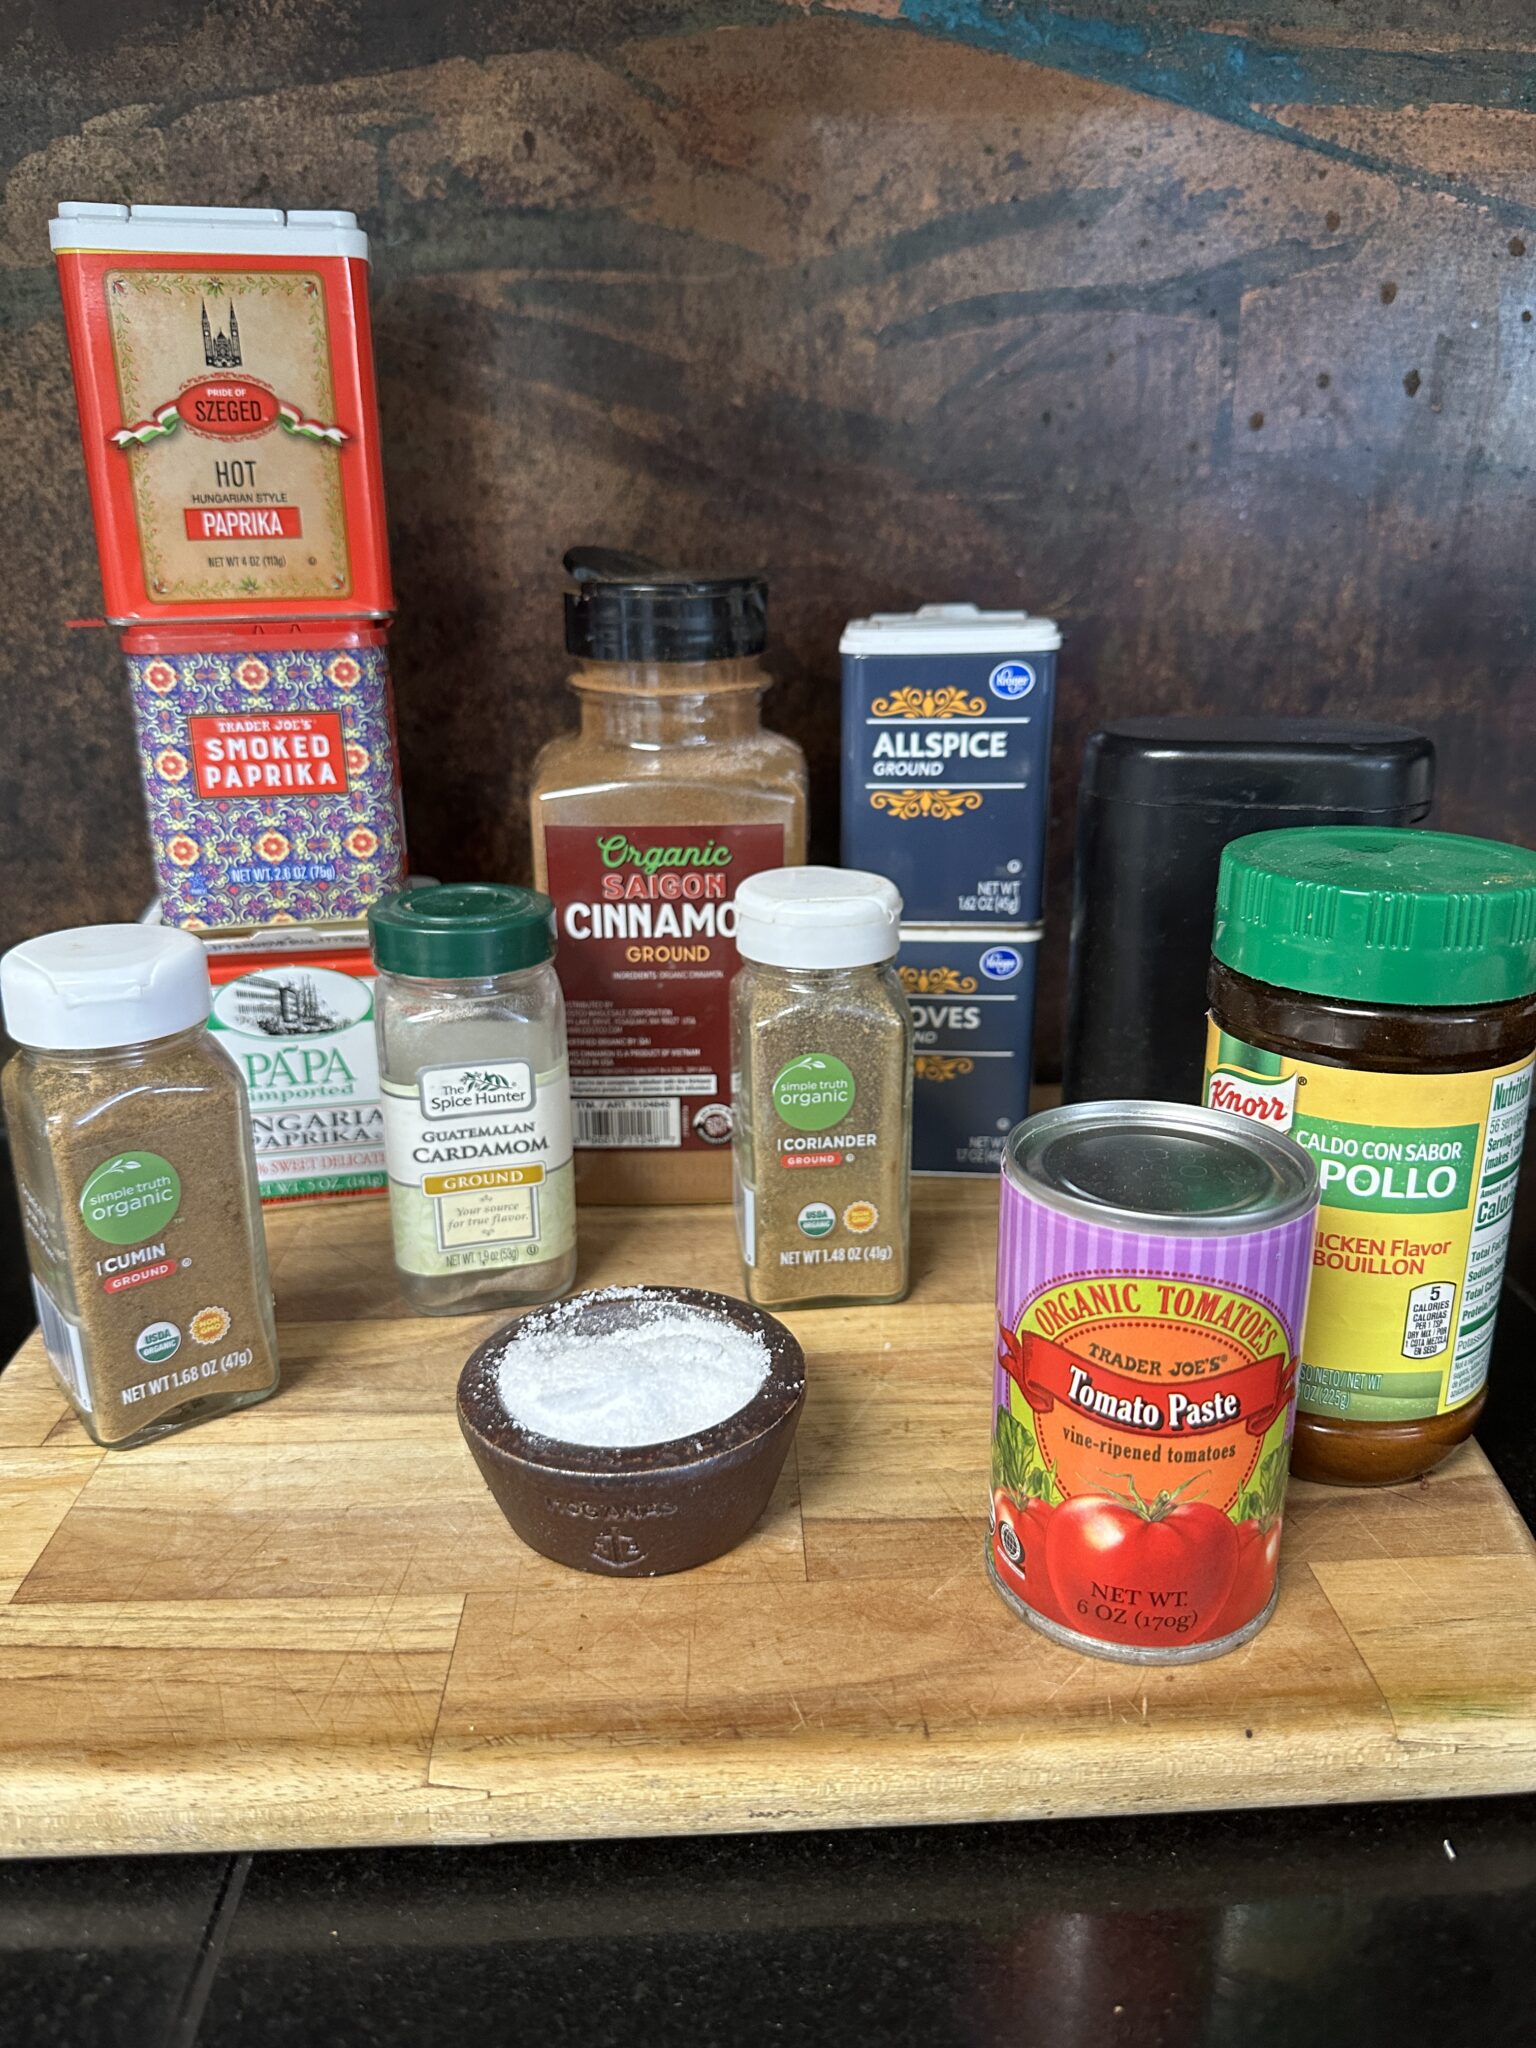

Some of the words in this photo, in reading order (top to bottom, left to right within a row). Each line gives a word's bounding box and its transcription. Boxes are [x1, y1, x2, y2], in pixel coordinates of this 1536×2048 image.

[206, 388, 232, 397] PRIDE
[234, 388, 246, 396] OF
[195, 400, 262, 422] SZEGED
[216, 461, 256, 488] HOT
[192, 494, 253, 504] HUNGARIAN
[256, 493, 288, 503] STYLE
[202, 510, 284, 537] PAPRIKA
[208, 557, 224, 568] NET
[224, 556, 239, 568] WT
[241, 556, 247, 566] 4
[249, 556, 260, 567] OZ
[996, 668, 1029, 694] Kroger
[218, 720, 272, 733] TRADER
[273, 719, 312, 732] JOE'S
[205, 734, 330, 761] SMOKED
[872, 731, 1008, 758] ALLSPICE
[205, 762, 337, 789] PAPRIKA
[873, 761, 944, 776] GROUND
[596, 834, 733, 875] Organic
[230, 868, 251, 882] NET
[252, 868, 273, 881] WT.
[294, 866, 307, 880] OZ
[310, 864, 335, 881] (75g)
[602, 873, 726, 900] SAIGON
[977, 880, 999, 896] NET
[1000, 880, 1022, 895] WT
[978, 896, 994, 912] OZ
[564, 902, 737, 940] CINNAMO
[626, 944, 710, 962] GROUND
[911, 1006, 981, 1030] OVES
[249, 1083, 354, 1104] imported
[443, 1086, 464, 1096] The
[781, 1081, 817, 1092] simple
[819, 1079, 848, 1089] truth
[432, 1096, 472, 1112] Spice
[475, 1092, 526, 1105] Hunter
[780, 1090, 848, 1106] organic
[1210, 1079, 1288, 1120] Knorr
[252, 1108, 384, 1133] NGARIA
[1490, 1118, 1500, 1134] 56
[422, 1122, 535, 1143] GUATEMALAN
[783, 1134, 877, 1151] CORIANDER
[1488, 1132, 1512, 1152] Serving
[413, 1136, 549, 1164] CARDAMOM
[1296, 1131, 1358, 1155] CALDO
[1362, 1141, 1401, 1160] CON
[1405, 1141, 1462, 1162] SABOR
[272, 1158, 316, 1175] SWEET
[787, 1155, 834, 1165] GROUND
[1484, 1150, 1510, 1173] (makes
[444, 1170, 524, 1190] GROUND
[1320, 1159, 1457, 1199] POLLO
[89, 1186, 134, 1205] simple
[136, 1176, 171, 1192] truth
[92, 1188, 173, 1220] organic
[456, 1206, 481, 1217] Your
[484, 1203, 519, 1213] source
[448, 1220, 464, 1232] for
[468, 1216, 489, 1226] true
[491, 1213, 528, 1226] flavor.
[806, 1210, 828, 1219] USDA
[1315, 1231, 1385, 1256] ICKEN
[1390, 1239, 1452, 1257] Flavor
[1472, 1244, 1490, 1262] Total
[105, 1242, 166, 1272] CUMIN
[446, 1253, 461, 1267] NET
[780, 1251, 801, 1265] NET
[803, 1250, 821, 1263] WT
[823, 1248, 846, 1262] 1.48
[848, 1247, 861, 1260] OZ
[863, 1245, 893, 1262] (41g)
[1313, 1250, 1425, 1276] BOUILLON
[112, 1264, 168, 1288] GROUND
[1430, 1286, 1440, 1300] 5
[1466, 1284, 1484, 1300] Total
[1413, 1300, 1450, 1312] CALORIES
[1413, 1310, 1447, 1322] CALORIAS
[1035, 1283, 1141, 1336] ORGANIC
[1158, 1285, 1279, 1356] TOMATOES
[1415, 1321, 1426, 1330] PER
[1433, 1319, 1443, 1328] TSP
[145, 1329, 172, 1345] USDA
[1408, 1331, 1419, 1339] DRY
[1421, 1330, 1431, 1338] MIX
[1436, 1327, 1447, 1335] POR
[1426, 1335, 1447, 1345] MEZCLA
[144, 1339, 176, 1356] ORGANIC
[1414, 1347, 1422, 1355] EN
[1423, 1345, 1437, 1354] SECO
[1089, 1342, 1161, 1376] TRADER
[121, 1383, 146, 1405] NET
[149, 1375, 170, 1395] WT
[172, 1366, 199, 1388] 1.68
[202, 1359, 218, 1377] OZ
[220, 1348, 253, 1372] (47g)
[1300, 1364, 1312, 1381] SO
[1368, 1374, 1382, 1390] WT
[1068, 1366, 1160, 1427] Tomato
[1168, 1391, 1238, 1428] Paste
[1304, 1384, 1317, 1401] OZ
[1319, 1387, 1350, 1410] (225g)
[1062, 1425, 1161, 1463] vine-ripened
[1168, 1443, 1236, 1463] tomatoes
[1091, 1581, 1141, 1606] NET
[1149, 1591, 1188, 1607] WT.
[1077, 1600, 1088, 1614] 6
[1096, 1605, 1127, 1624] OZ
[1135, 1610, 1198, 1632] (170g)
